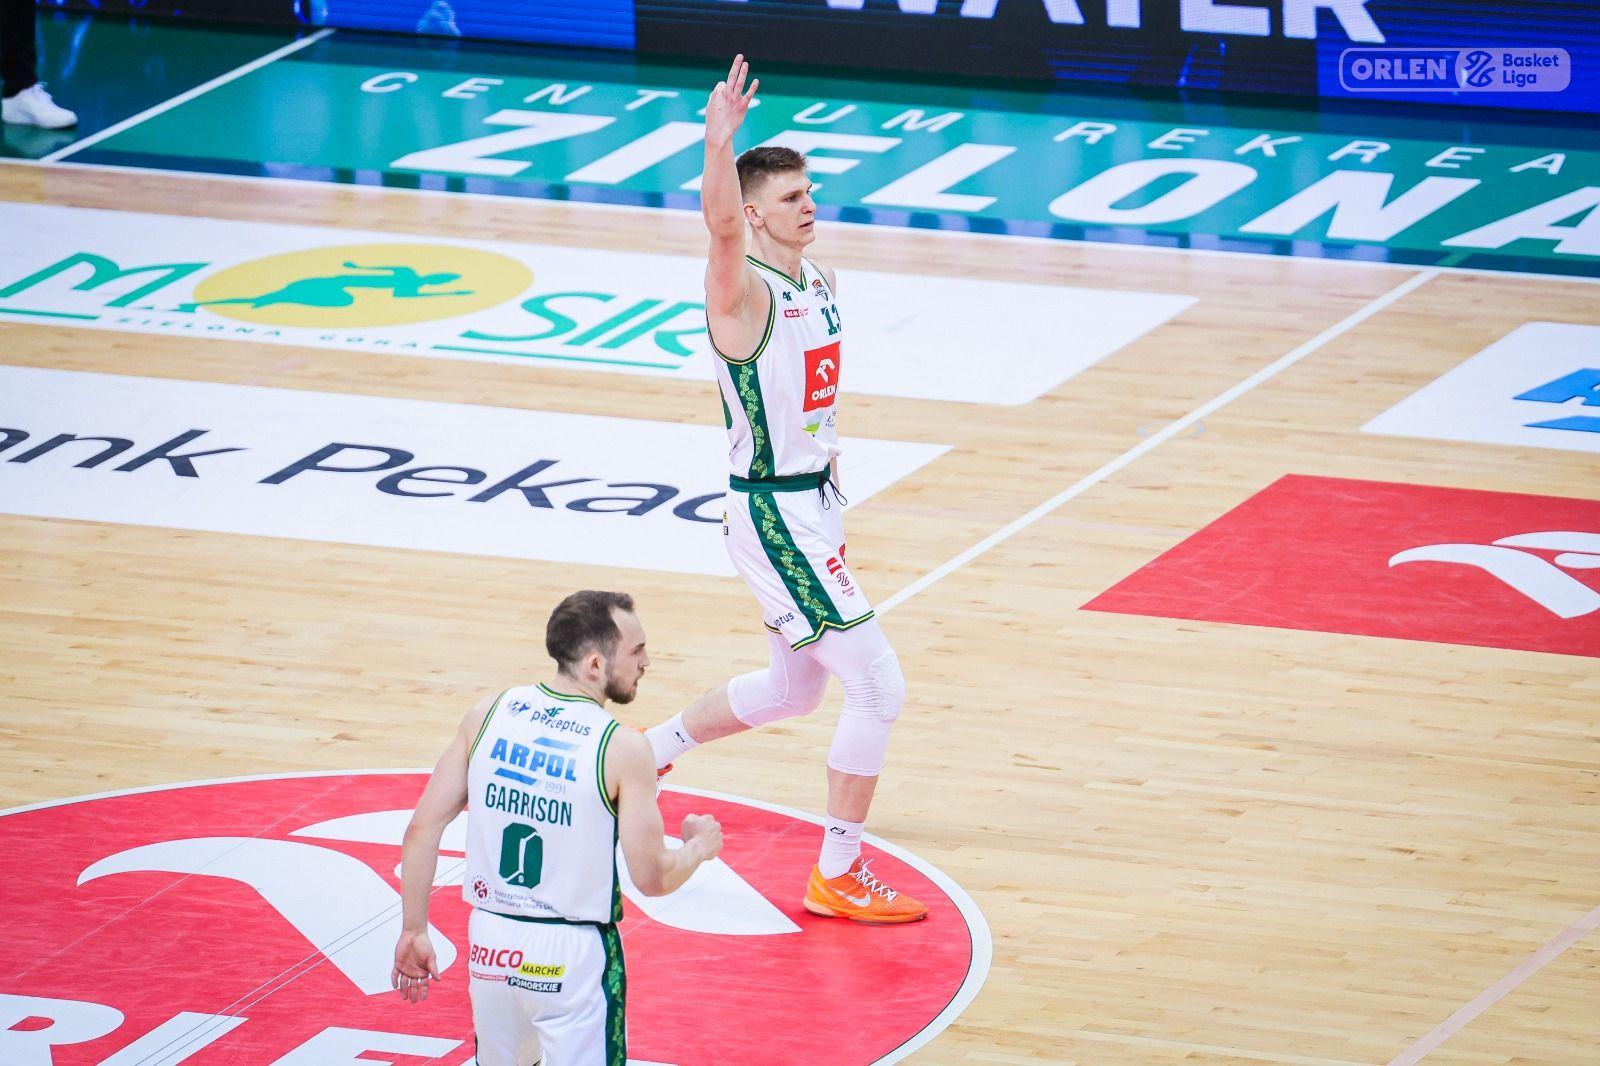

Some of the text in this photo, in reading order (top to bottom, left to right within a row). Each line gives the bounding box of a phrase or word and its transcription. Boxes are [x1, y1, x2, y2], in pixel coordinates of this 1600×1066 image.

[360, 71, 965, 133] CENTUM
[529, 709, 592, 738] perceptus
[490, 737, 577, 783] ARPOL
[544, 779, 567, 796] 1991
[484, 781, 573, 828] GARRISON
[470, 944, 525, 969] BRICO
[509, 976, 559, 993] POMORSKIE
